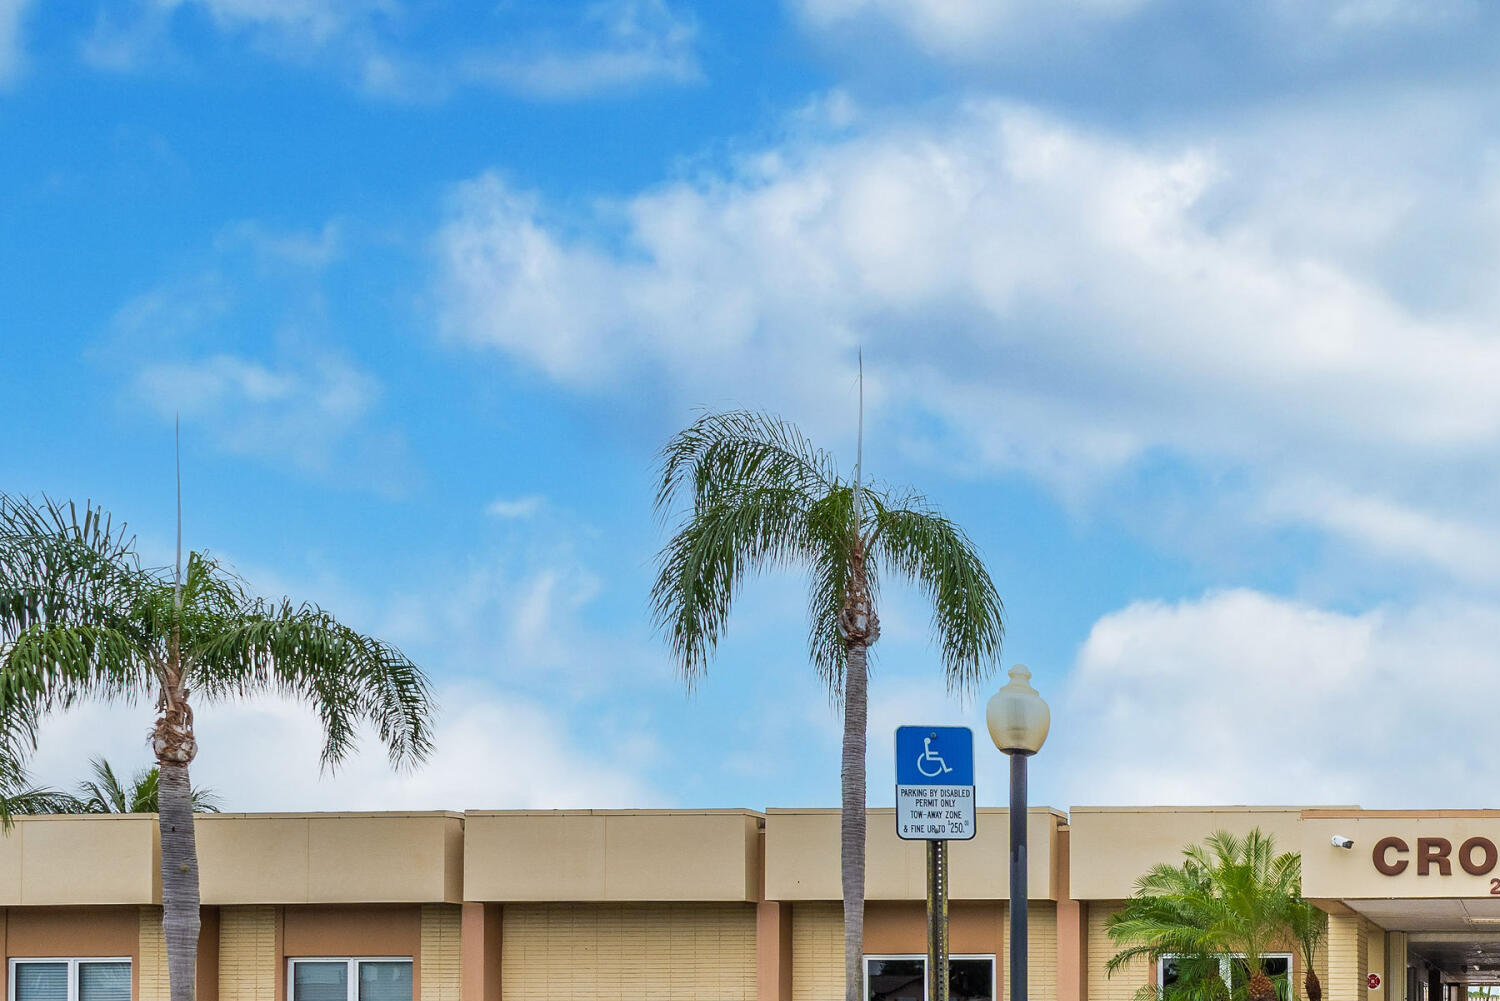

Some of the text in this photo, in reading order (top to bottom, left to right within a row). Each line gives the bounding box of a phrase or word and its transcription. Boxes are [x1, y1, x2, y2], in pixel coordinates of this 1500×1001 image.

[901, 789, 970, 798] PARKING BY DISABLED
[916, 799, 956, 807] PERMIT ONLY
[910, 810, 962, 819] TOW-AWAY ZONE
[903, 824, 908, 833] &
[911, 825, 925, 833] FINE
[927, 825, 936, 833] UP
[938, 825, 945, 833] TO
